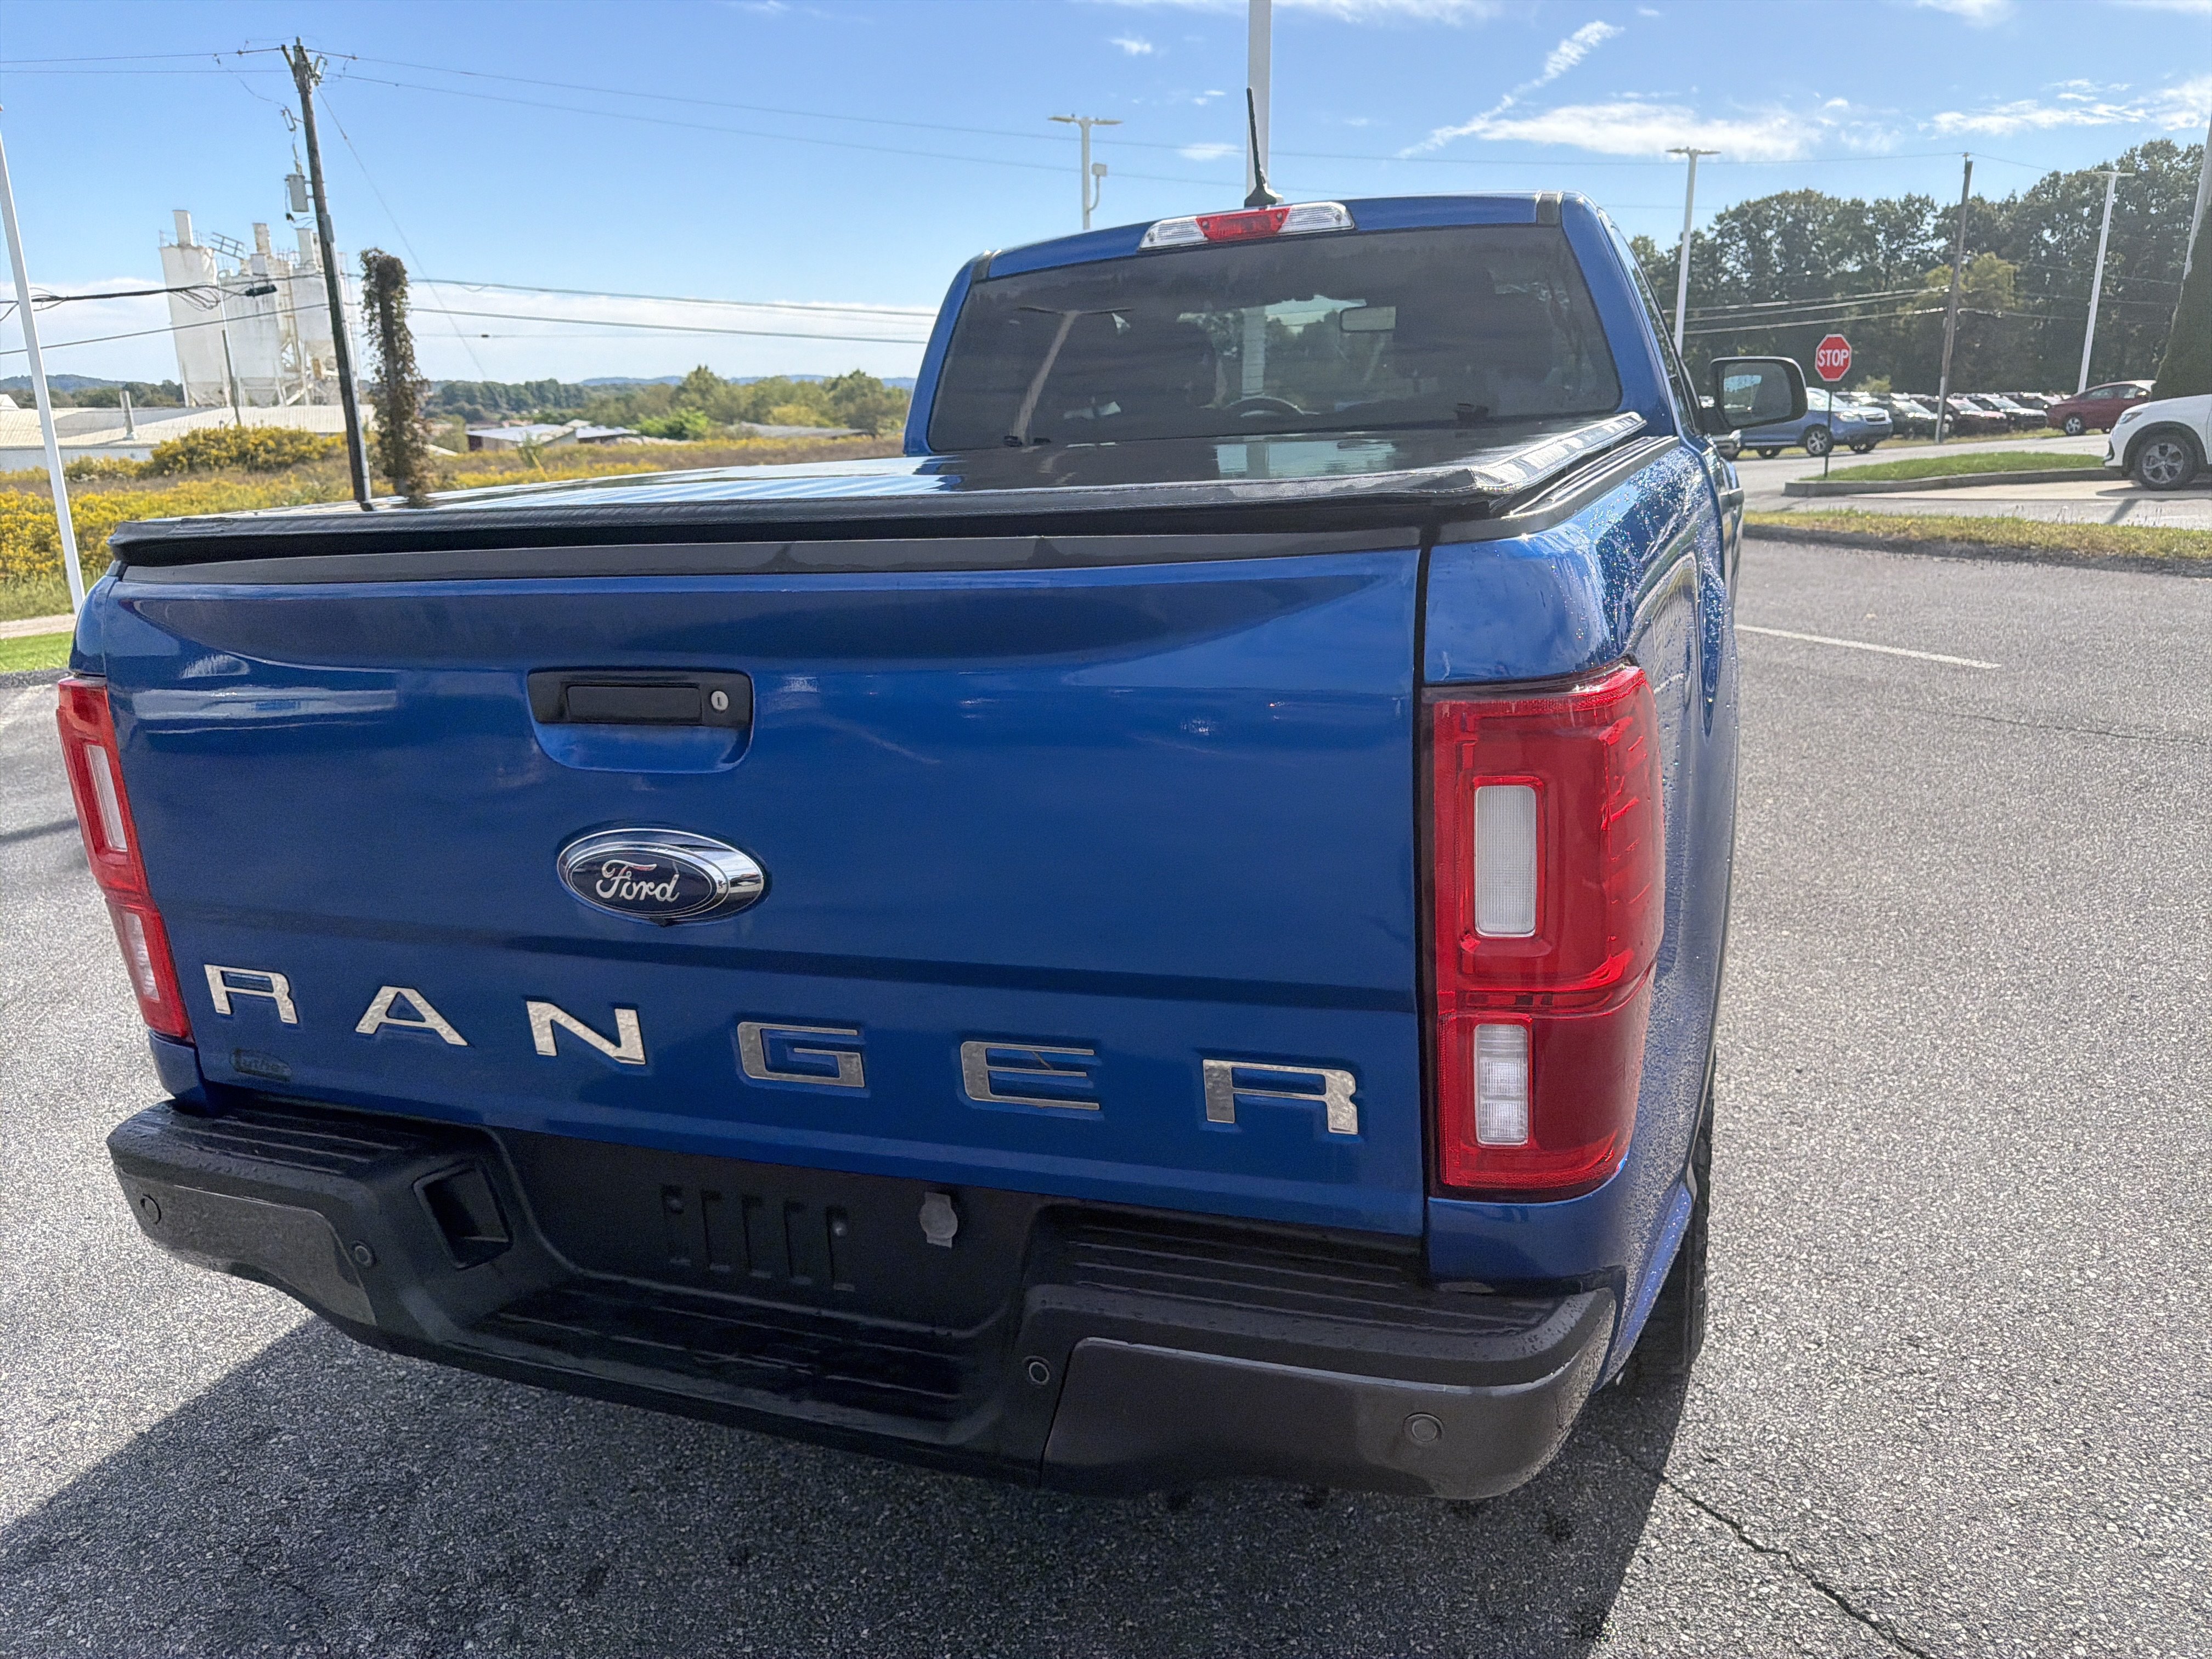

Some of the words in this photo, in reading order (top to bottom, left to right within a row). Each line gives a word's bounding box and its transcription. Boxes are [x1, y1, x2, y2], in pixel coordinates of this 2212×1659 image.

[1818, 349, 1849, 367] STOP
[596, 859, 682, 903] Ford
[204, 964, 1359, 1135] RANGER
